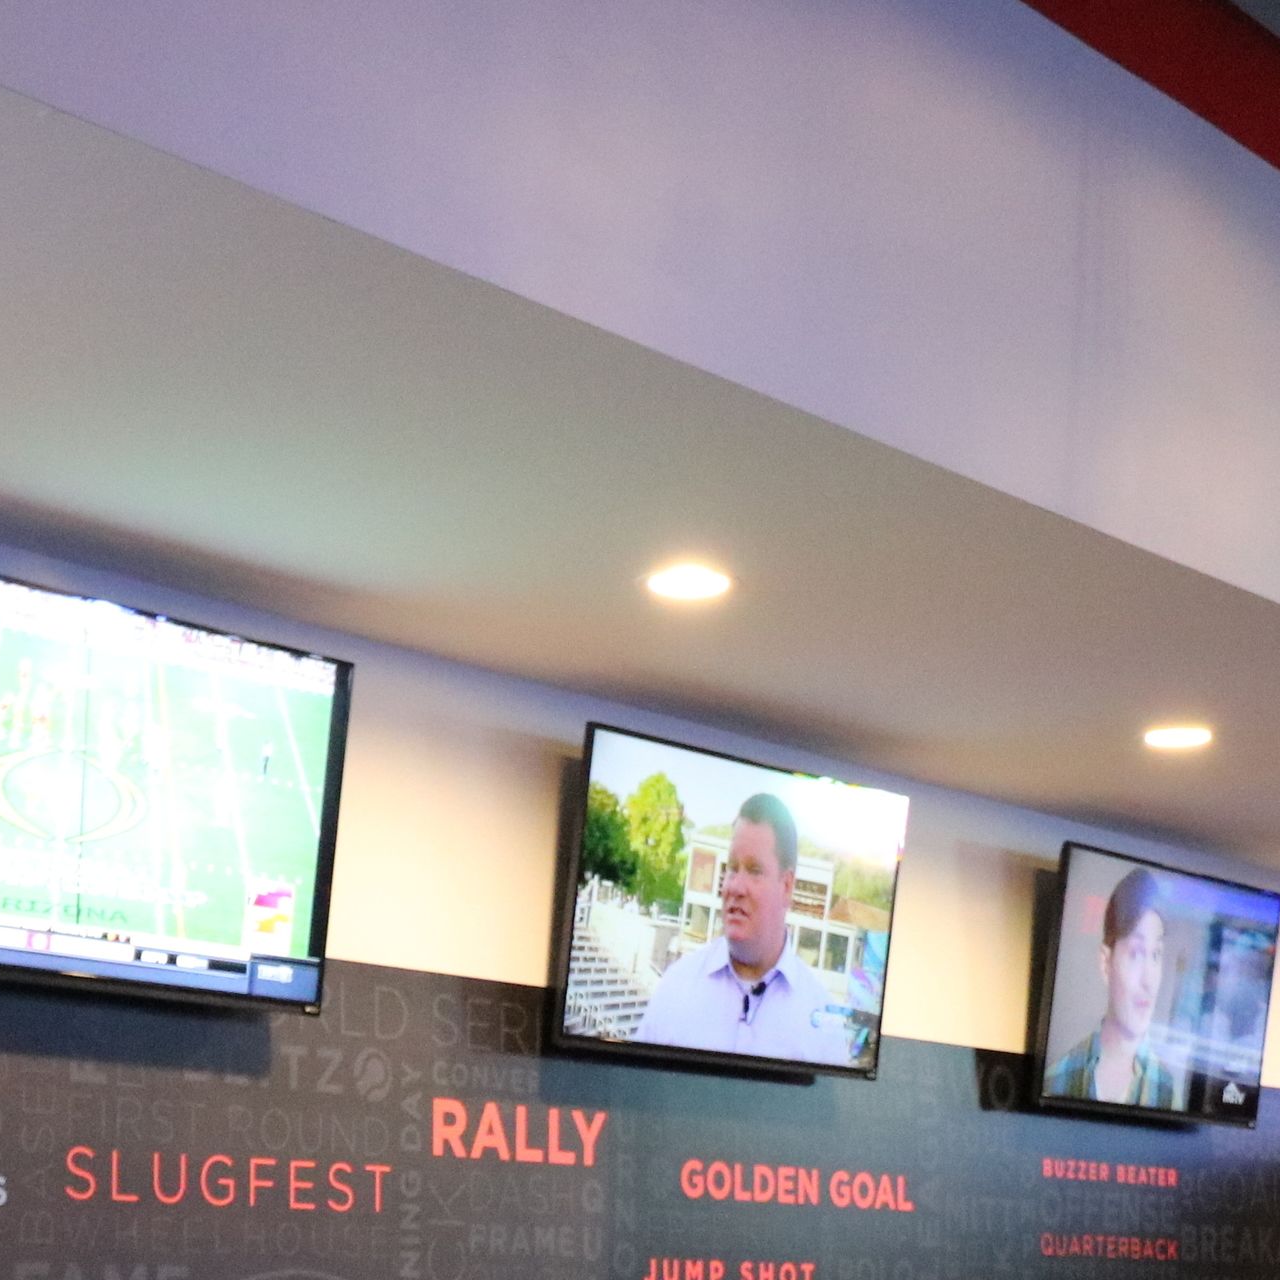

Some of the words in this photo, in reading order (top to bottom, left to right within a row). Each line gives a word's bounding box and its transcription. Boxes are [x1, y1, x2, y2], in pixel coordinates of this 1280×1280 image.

[431, 1097, 607, 1167] RALLY
[63, 1144, 393, 1216] SLUGFEST
[679, 1157, 819, 1206] GOLDEN
[829, 1169, 916, 1213] GOAL
[1041, 1157, 1110, 1182] BUZZER
[1116, 1163, 1178, 1188] BEATER
[1040, 1232, 1179, 1261] QUARTERBACK
